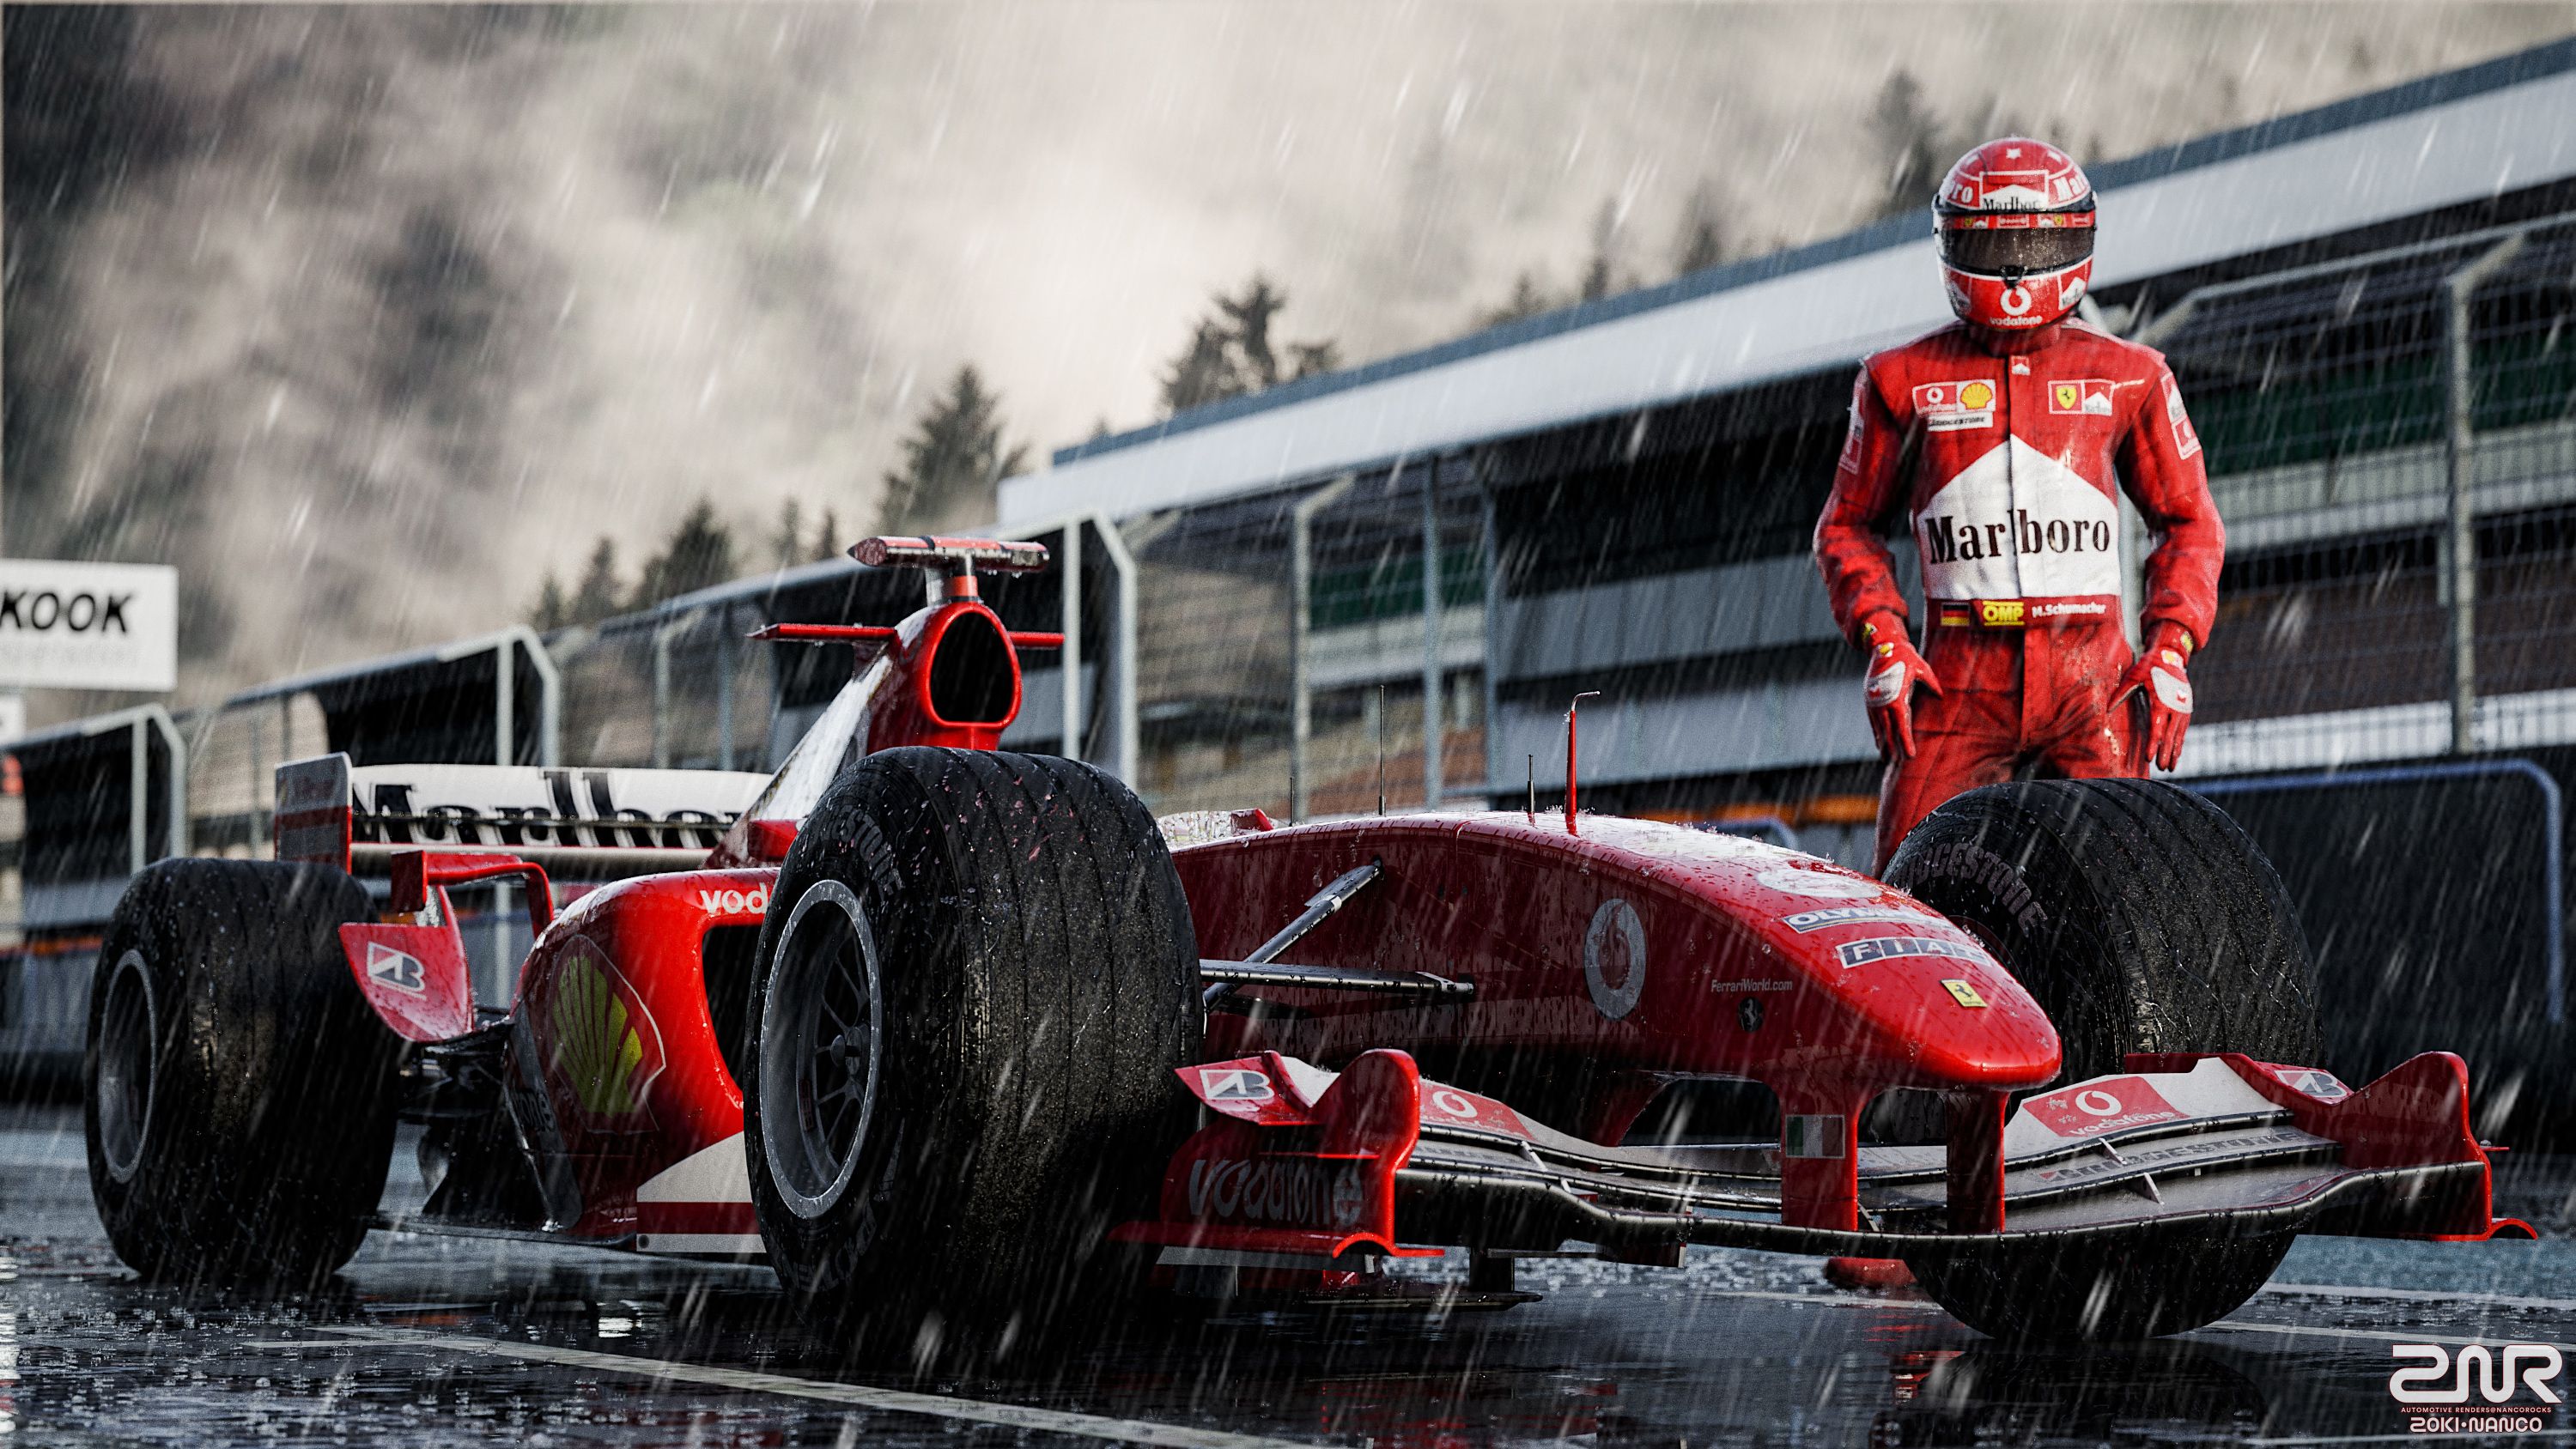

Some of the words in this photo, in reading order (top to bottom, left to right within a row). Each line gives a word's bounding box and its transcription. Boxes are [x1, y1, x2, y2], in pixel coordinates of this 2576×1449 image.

[1990, 315, 2043, 326] vodafone
[1925, 508, 2111, 564] Marlboro
[1983, 604, 2025, 622] OMP
[1710, 979, 1793, 992] FerrariWorld.com
[2069, 1111, 2177, 1136] vodafone
